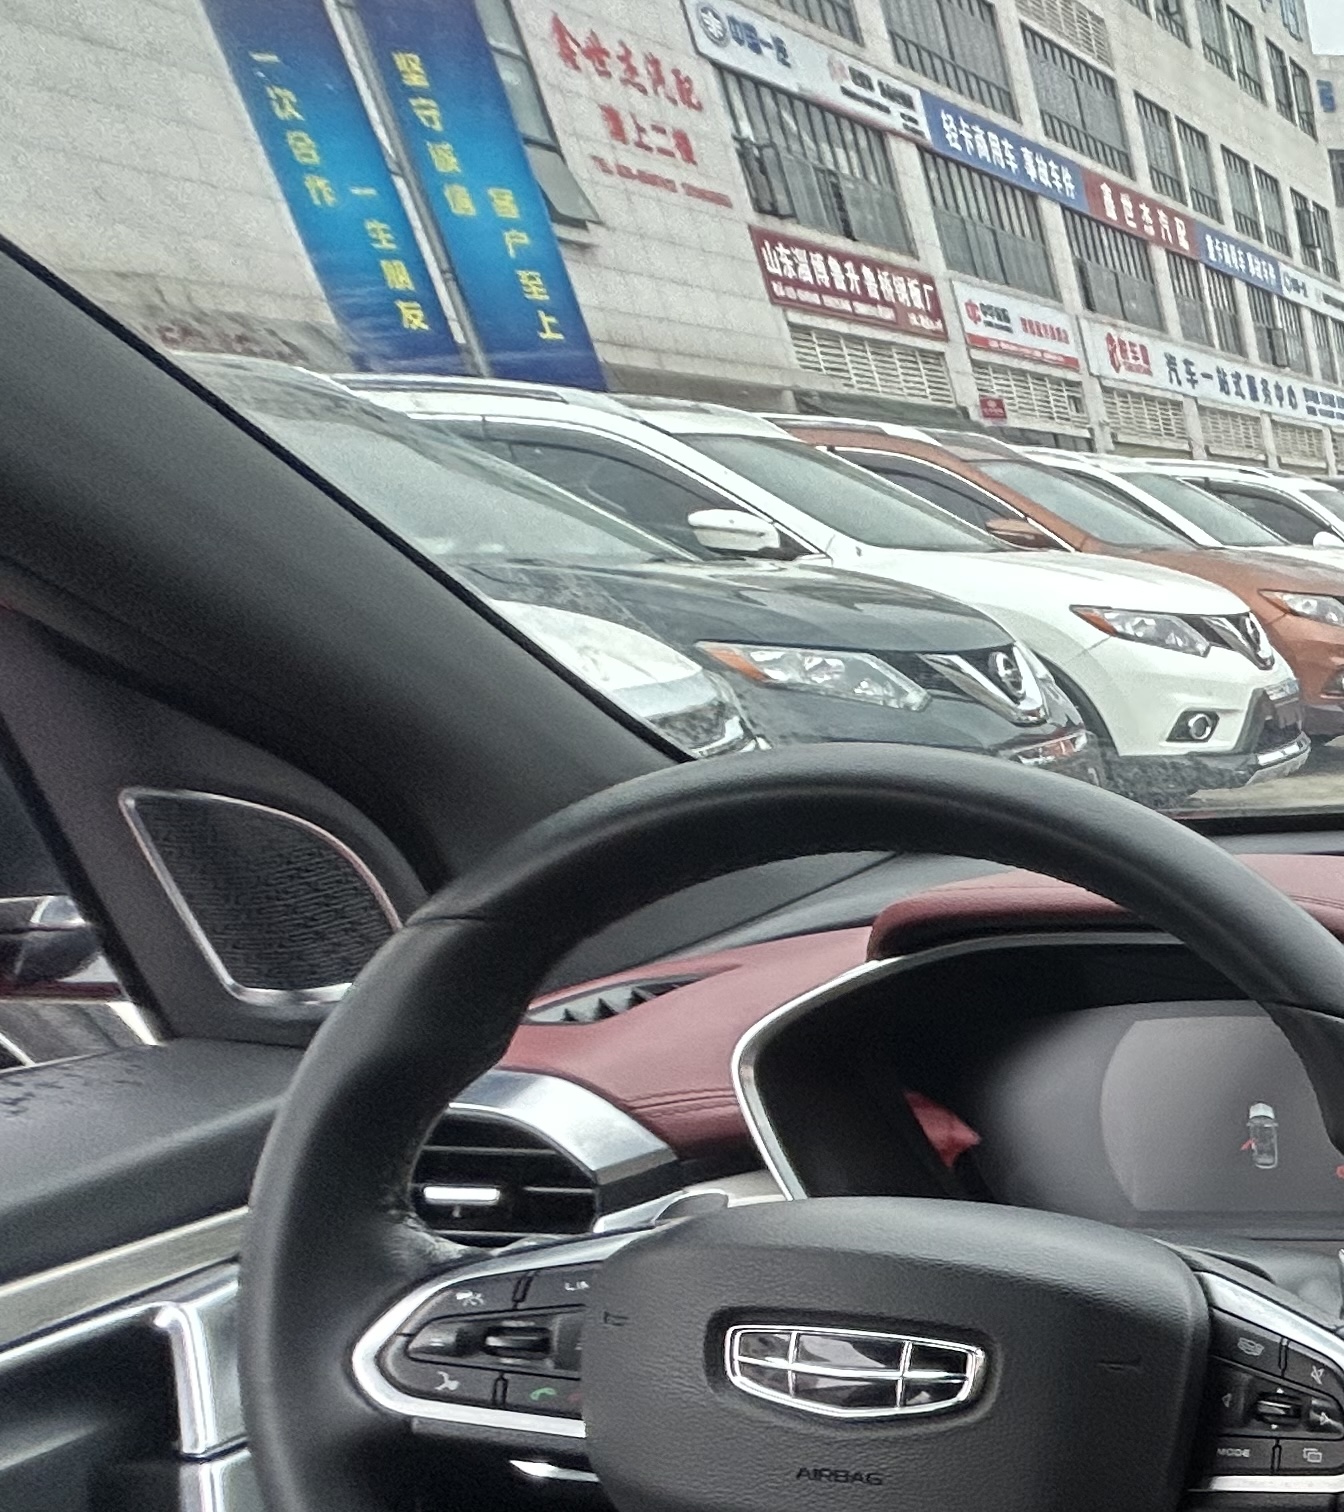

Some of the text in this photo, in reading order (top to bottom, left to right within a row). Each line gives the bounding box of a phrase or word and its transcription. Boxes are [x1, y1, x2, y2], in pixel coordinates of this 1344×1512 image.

[248, 51, 339, 208] 一次合作
[392, 50, 477, 217] 坚守诚信
[939, 109, 1018, 172] 轻卡商用车
[350, 186, 431, 332] 一生朋友
[488, 187, 564, 341] 客户至上
[1163, 351, 1298, 410] 汽车一站式服务中心
[796, 1466, 884, 1487] AIRBAG
[1217, 1446, 1250, 1459] MODE
